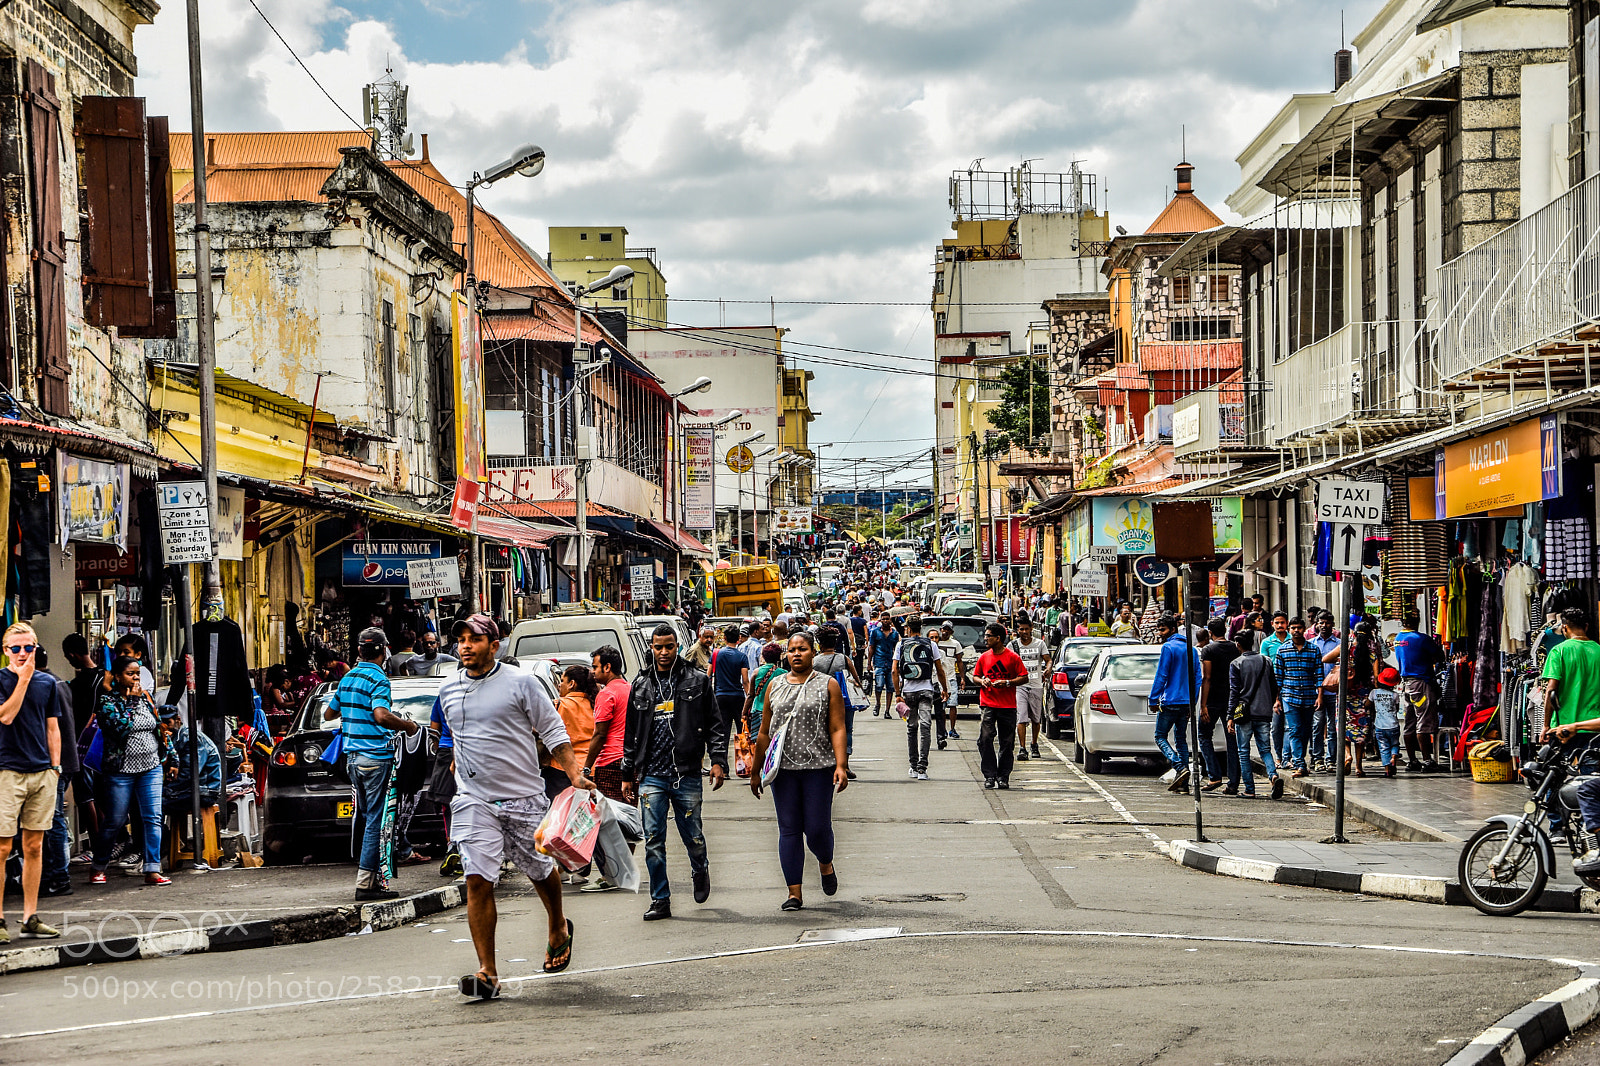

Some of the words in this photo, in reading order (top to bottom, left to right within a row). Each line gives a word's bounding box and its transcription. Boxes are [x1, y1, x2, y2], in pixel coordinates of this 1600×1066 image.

[735, 422, 752, 431] LTD
[689, 446, 709, 455] SPECIALE
[1469, 438, 1509, 472] MARLON
[1333, 487, 1370, 502] TAXI
[1321, 504, 1379, 519] STAND
[164, 519, 184, 527] Limit
[194, 518, 206, 526] hrs
[169, 531, 187, 539] Mon
[193, 530, 204, 538] Fri
[1117, 528, 1152, 543] DHANY'S
[169, 544, 206, 554] Saturday
[352, 543, 378, 555] CHAN
[380, 543, 399, 555] KIN
[401, 543, 432, 555] SNACK
[75, 558, 128, 572] orange
[434, 559, 457, 567] COUNCIL
[411, 580, 443, 589] HAWKING
[420, 586, 451, 596] ALLOWED
